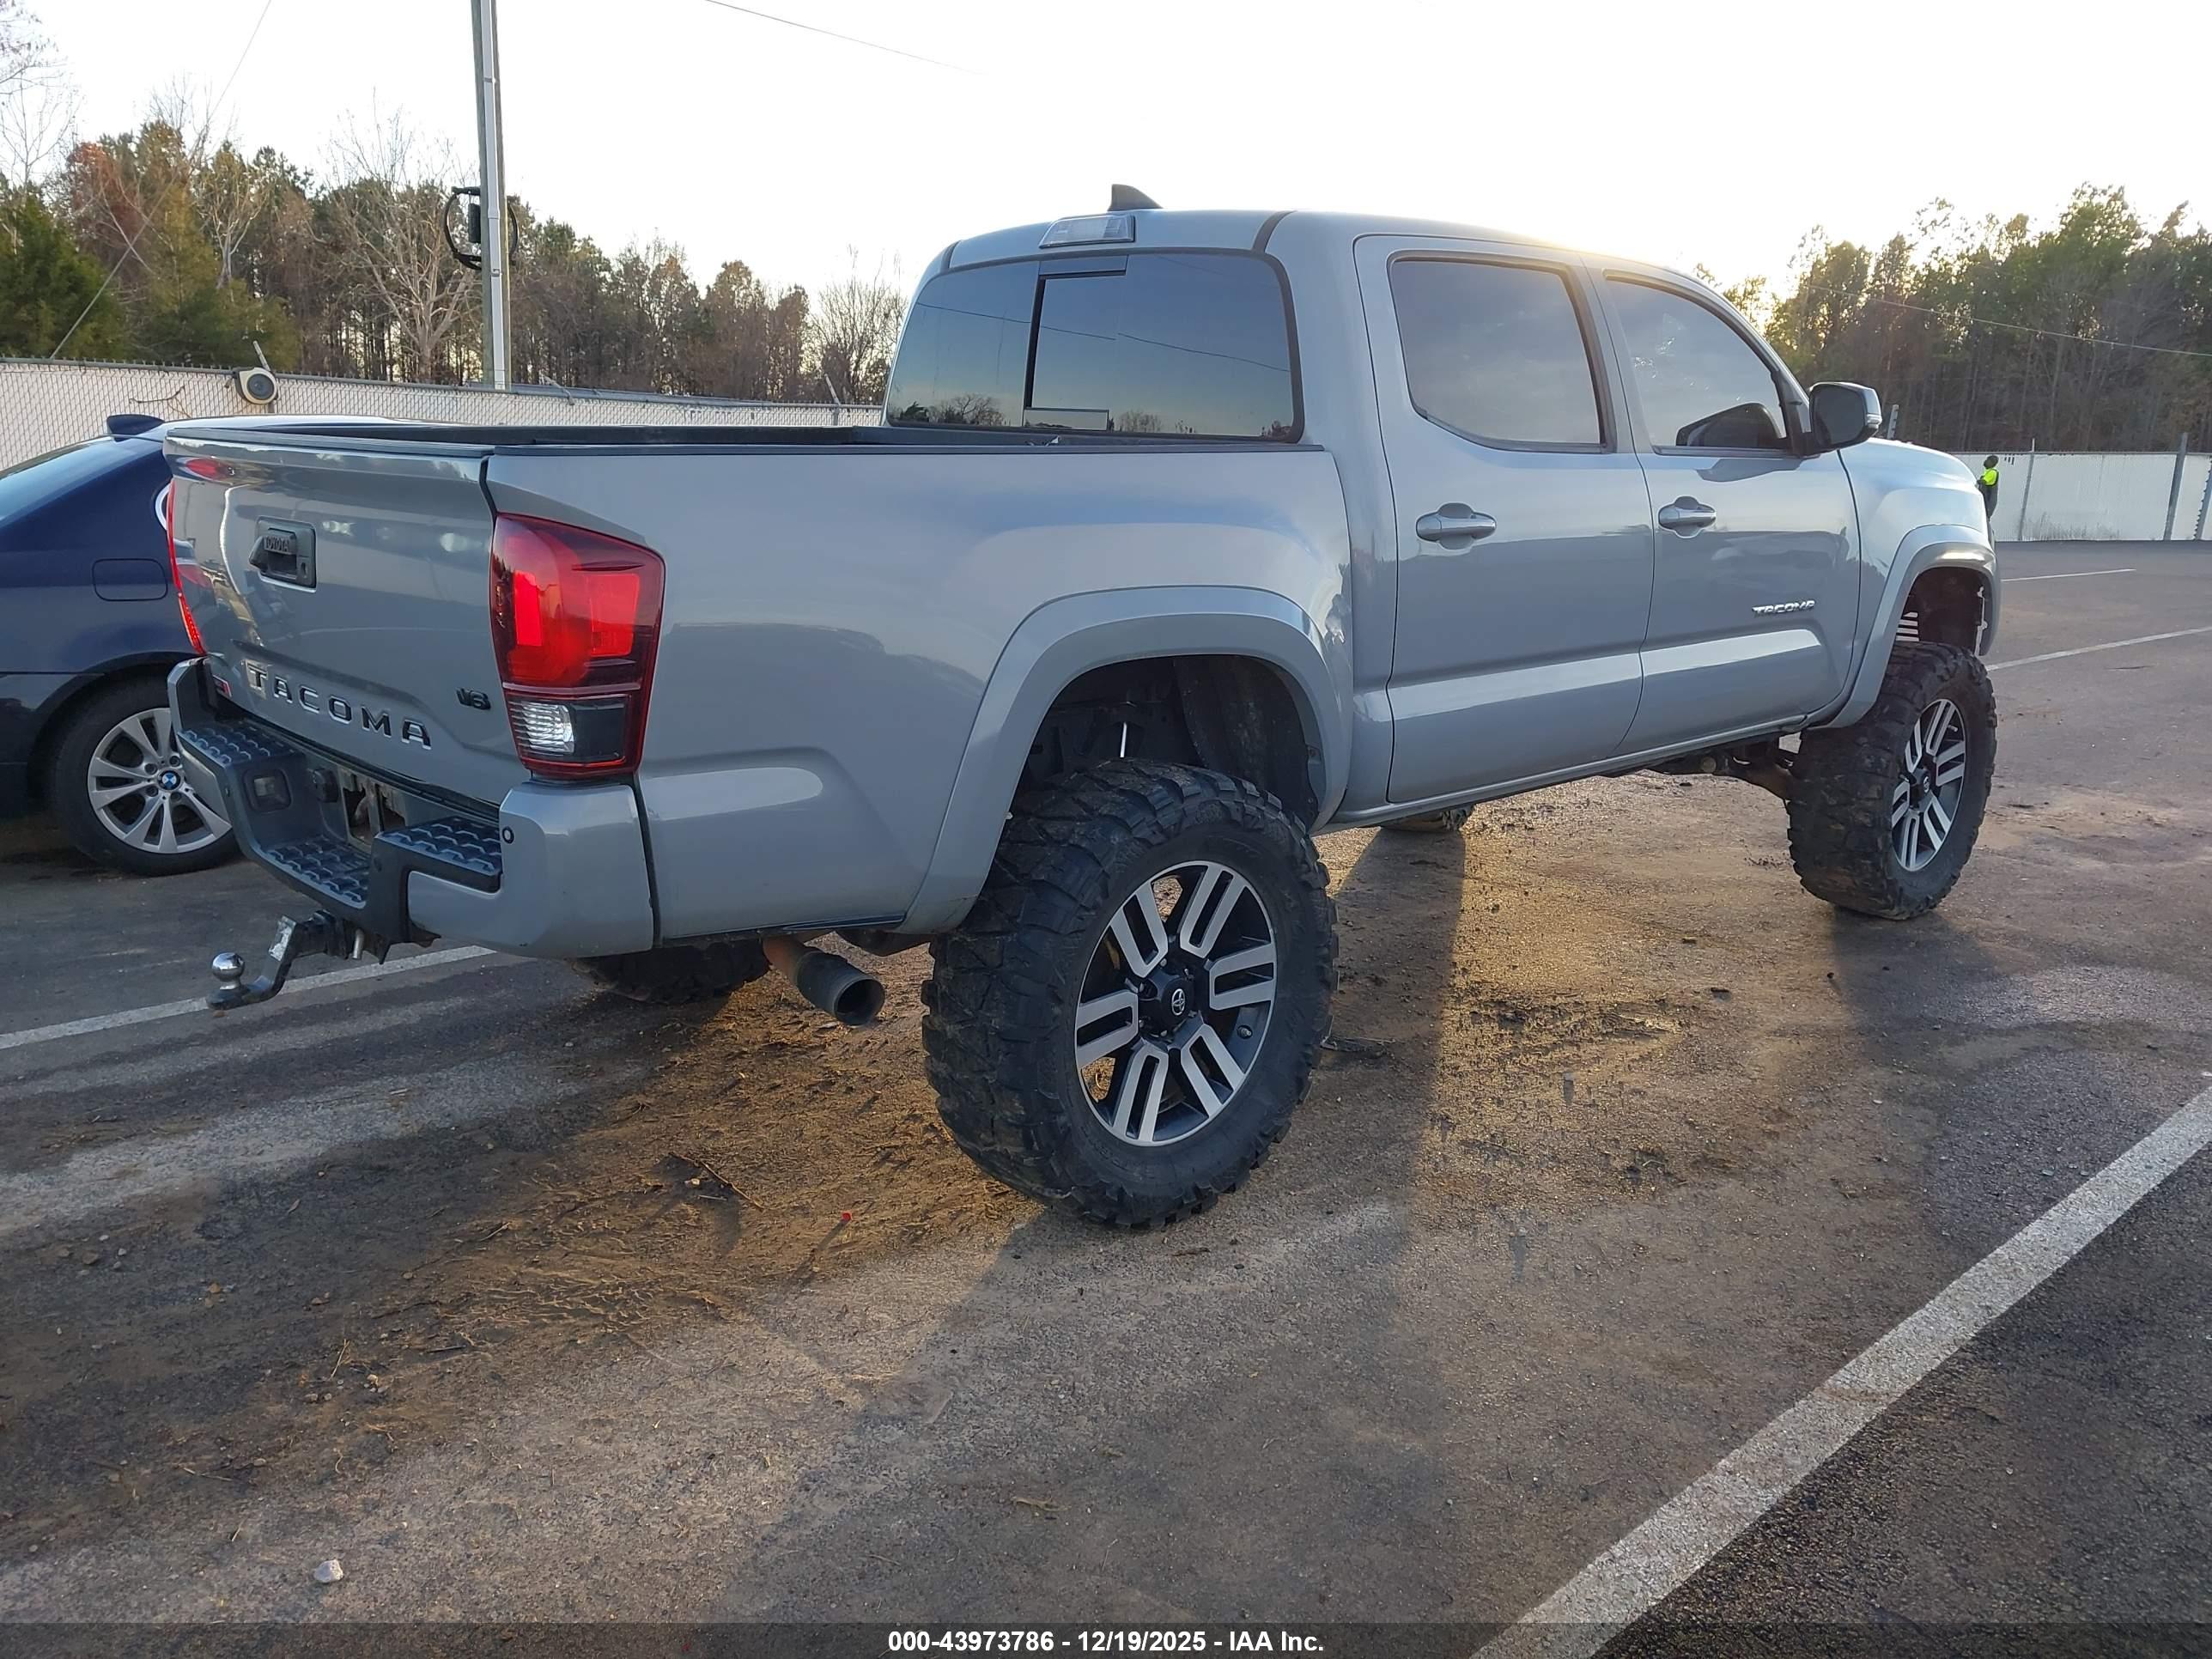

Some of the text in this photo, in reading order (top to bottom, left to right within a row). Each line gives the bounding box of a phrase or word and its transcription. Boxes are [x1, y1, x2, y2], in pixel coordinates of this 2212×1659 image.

[263, 536, 290, 552] TOYOTA
[1752, 600, 1815, 615] TACOMA
[246, 663, 432, 750] TACOMA
[456, 688, 491, 710] V6
